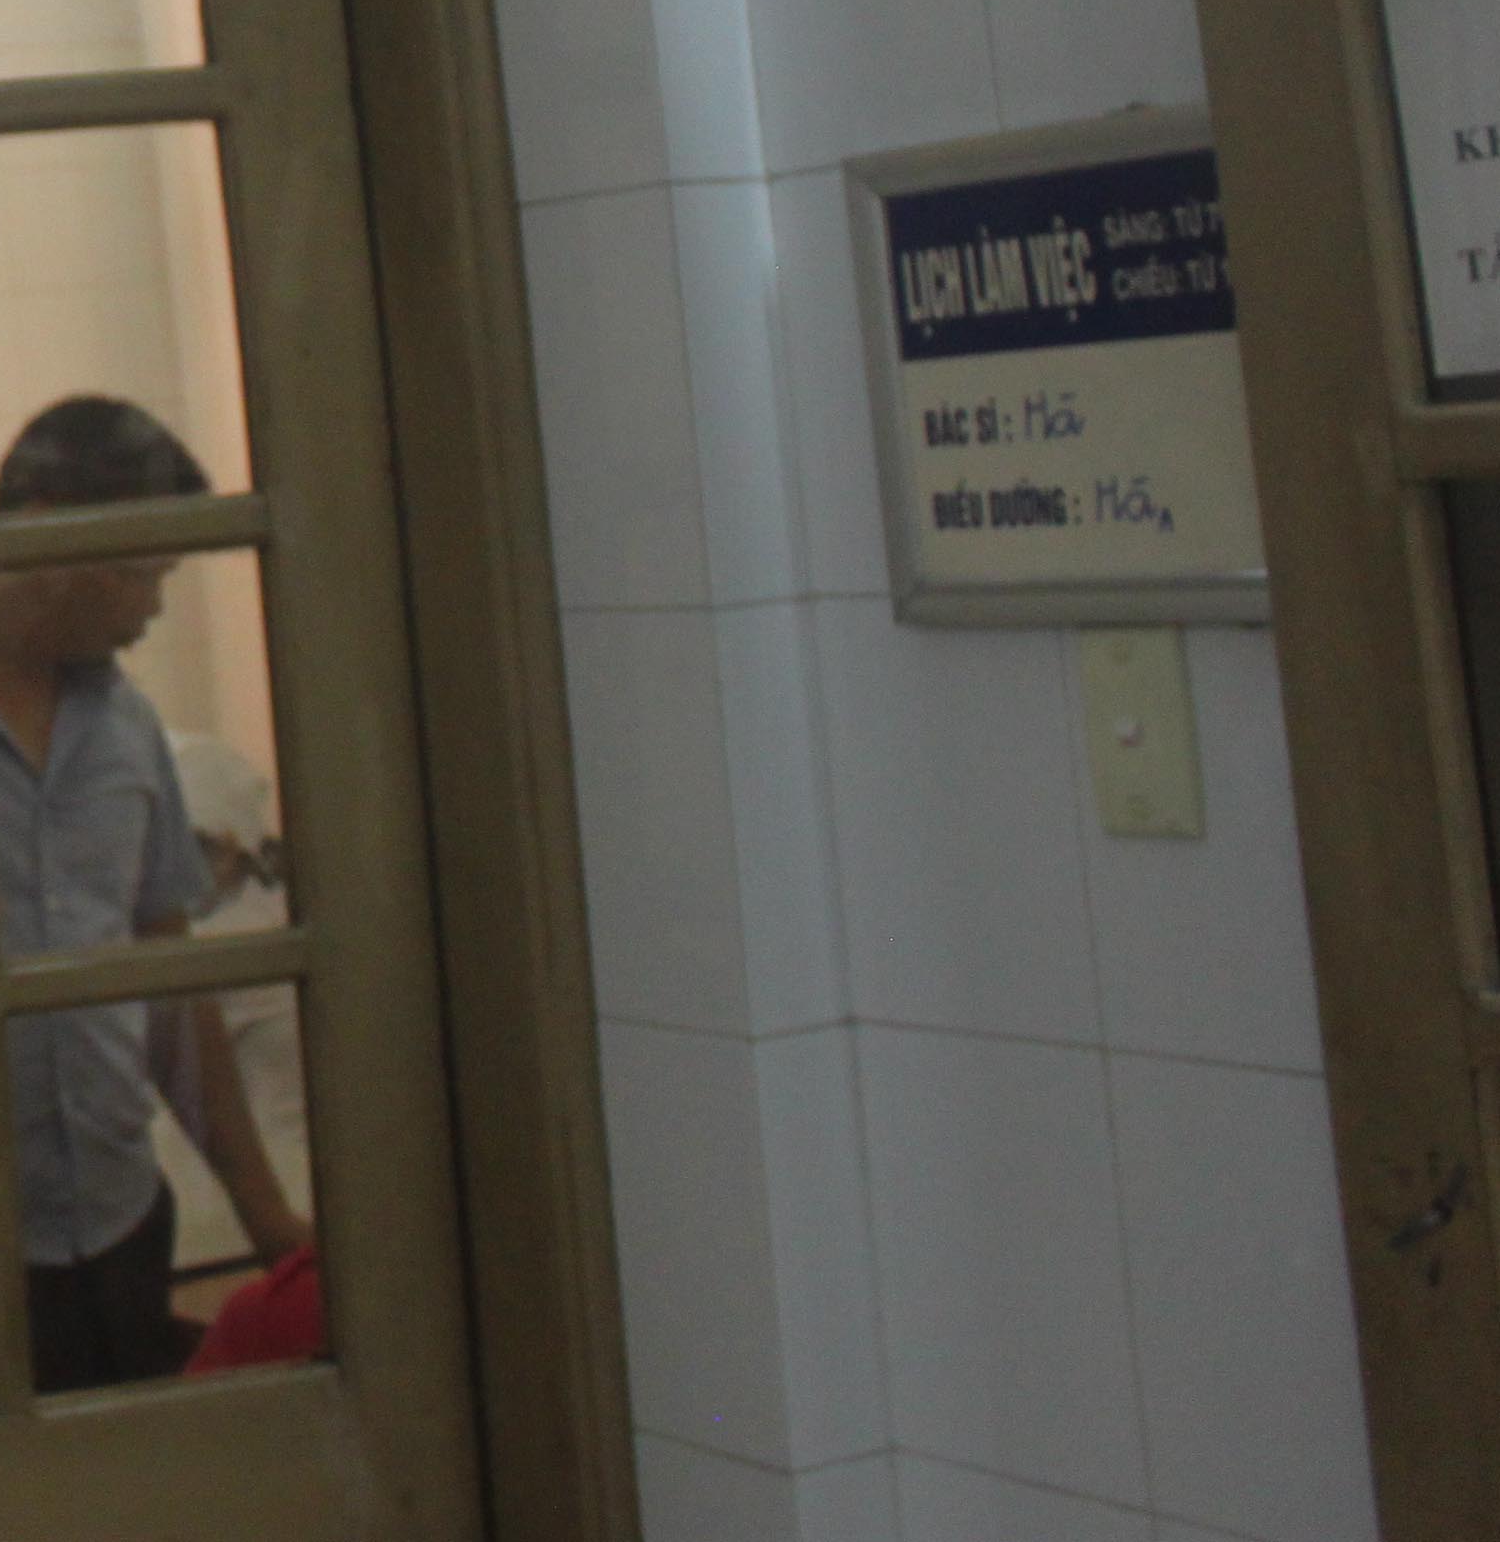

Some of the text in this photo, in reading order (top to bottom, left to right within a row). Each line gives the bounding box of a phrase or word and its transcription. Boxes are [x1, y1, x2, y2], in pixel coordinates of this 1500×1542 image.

[902, 214, 1097, 340] LỊCH LÀM VIỆC
[924, 401, 969, 447] BÁC
